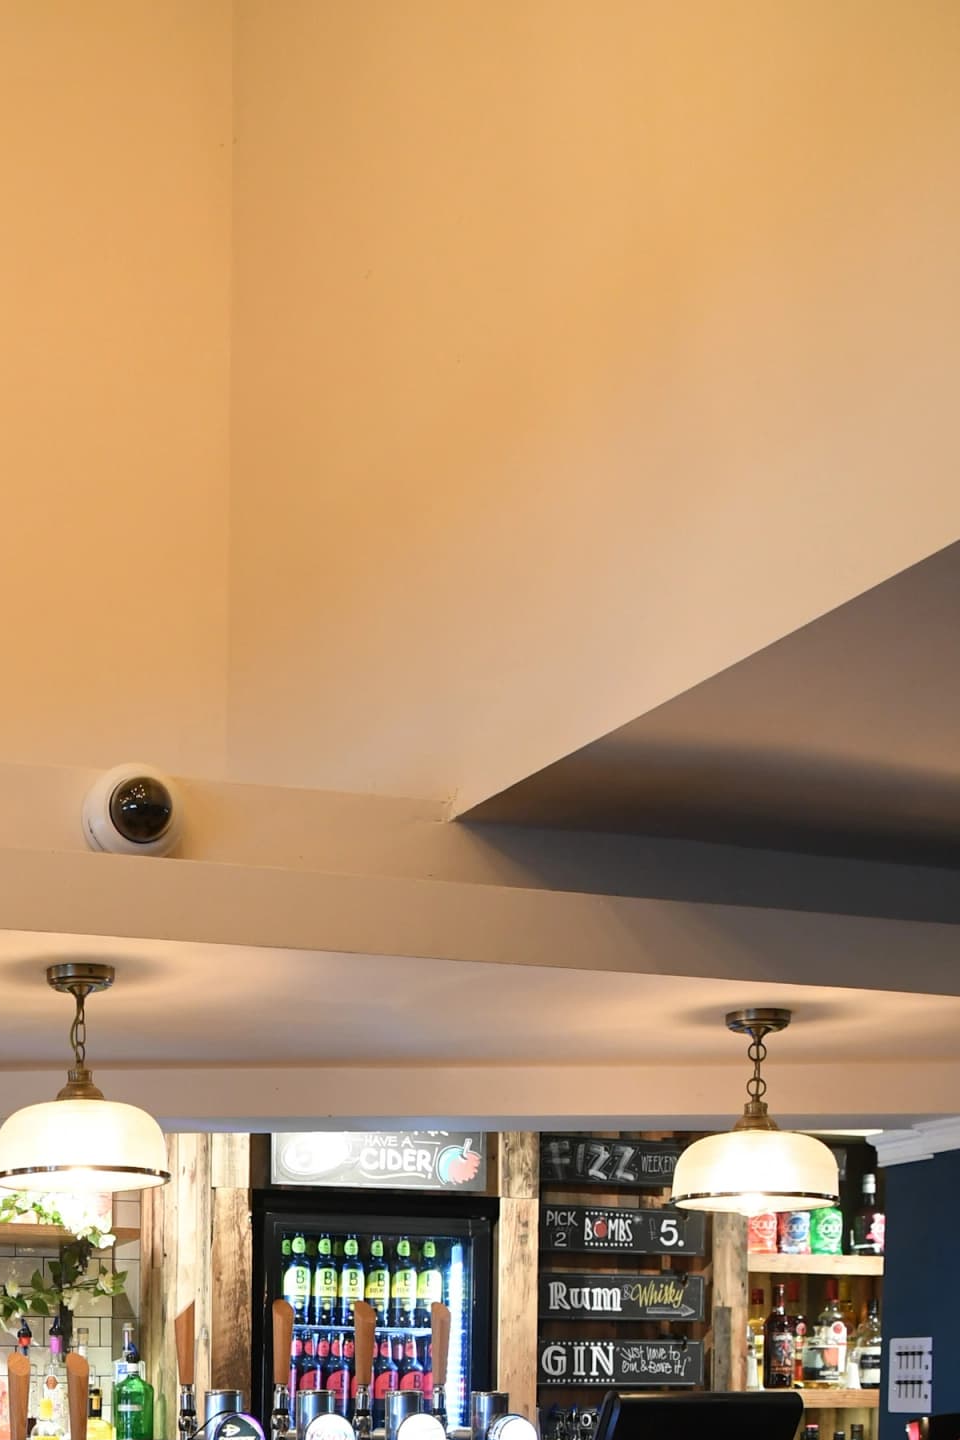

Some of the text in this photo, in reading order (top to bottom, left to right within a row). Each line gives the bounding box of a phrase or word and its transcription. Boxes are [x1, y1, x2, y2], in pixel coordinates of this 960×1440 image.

[363, 1136, 414, 1148] HAVE A
[545, 1141, 635, 1181] FIZZ
[546, 1210, 578, 1227] PICK
[554, 1232, 567, 1247] 2
[548, 1282, 622, 1311] Rum
[630, 1280, 686, 1308] Whisky
[541, 1345, 615, 1376] GIN
[669, 1345, 681, 1360] to
